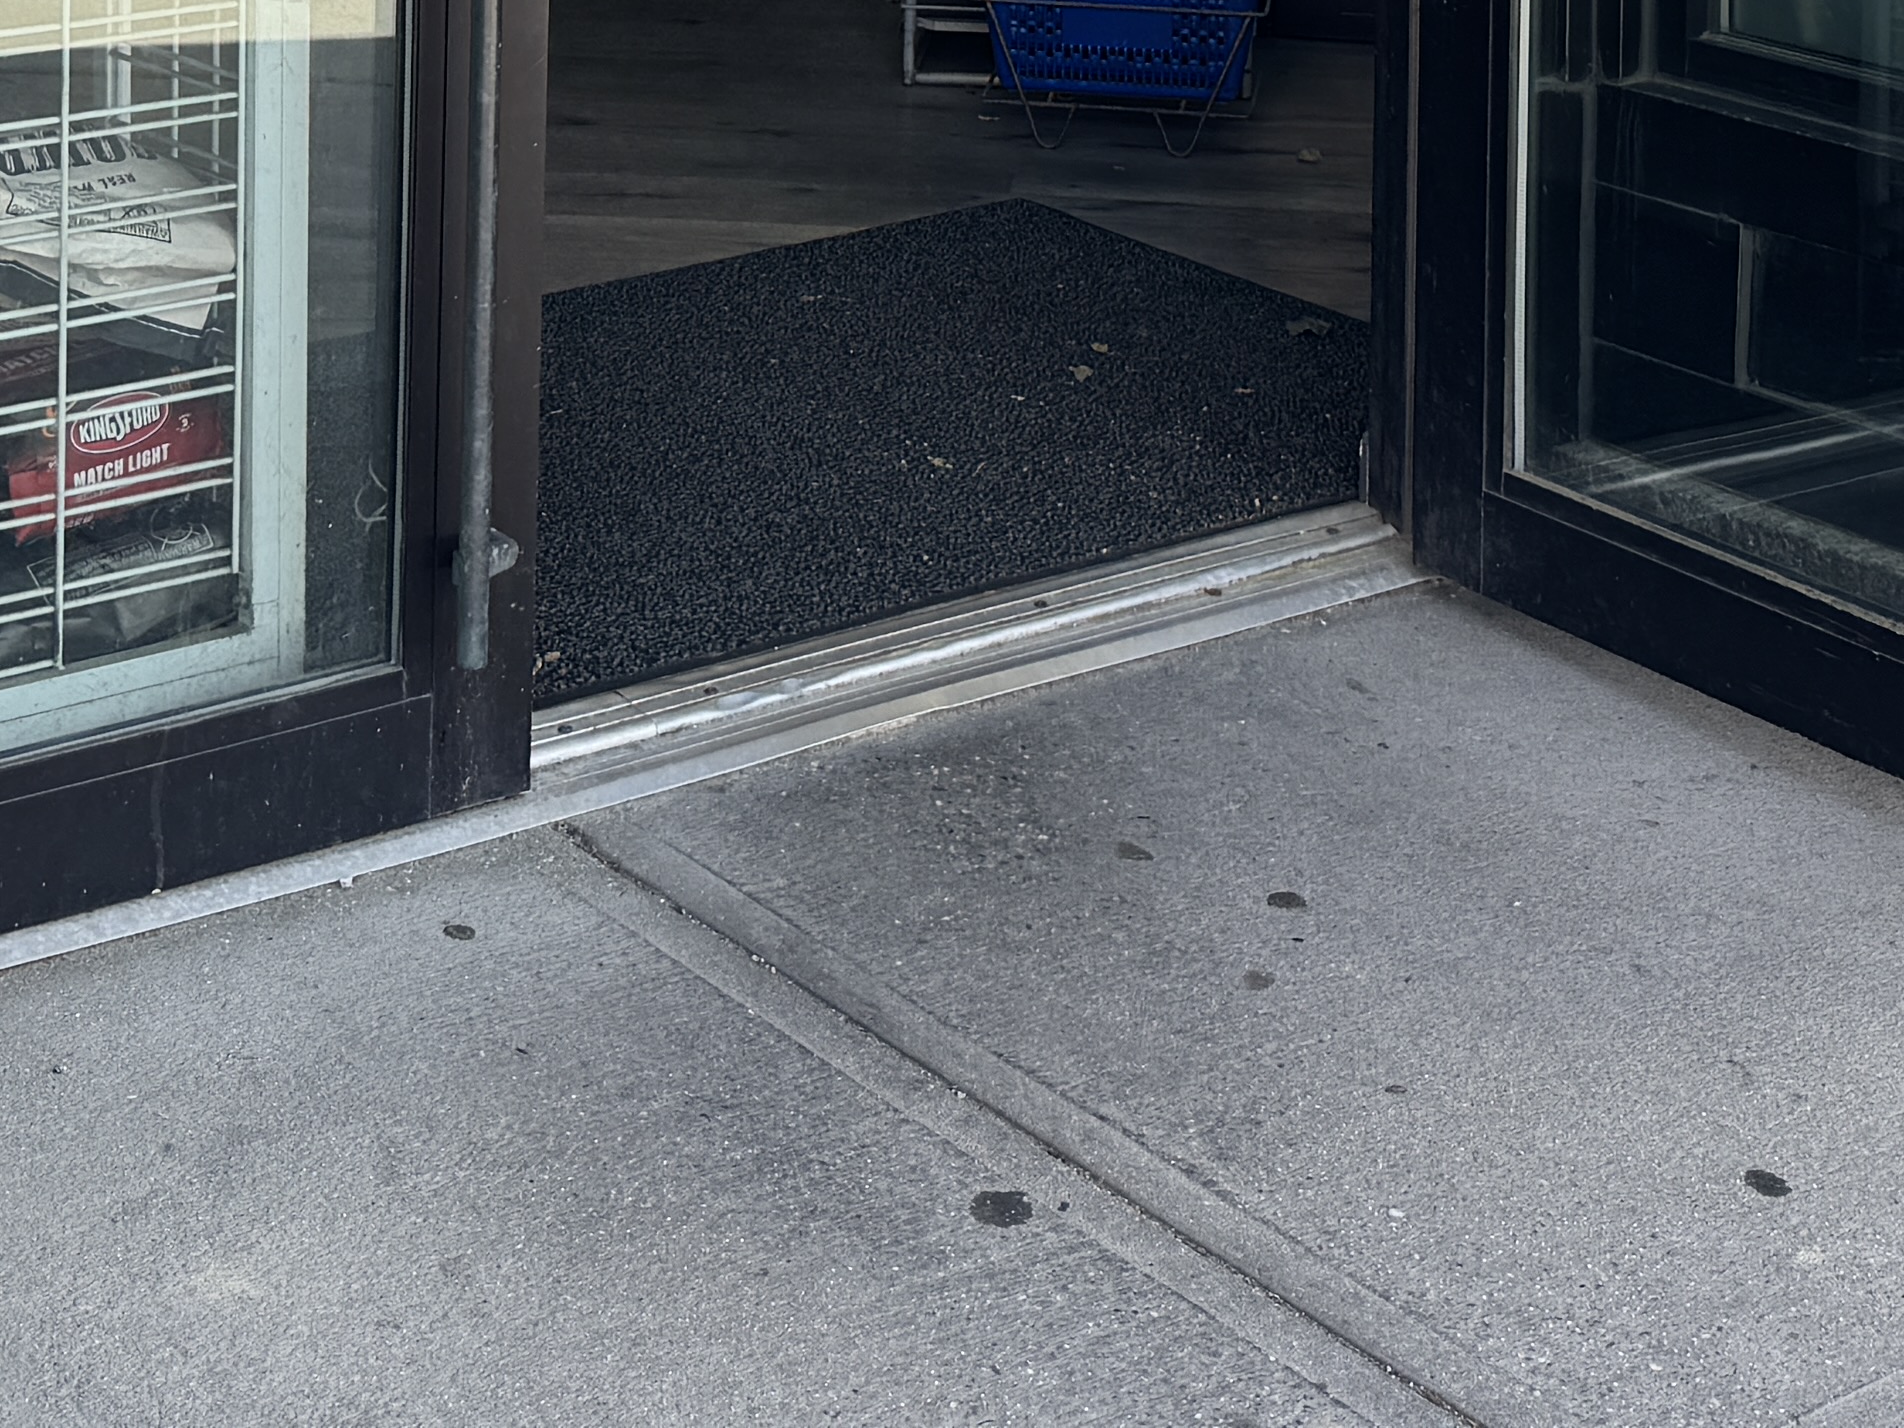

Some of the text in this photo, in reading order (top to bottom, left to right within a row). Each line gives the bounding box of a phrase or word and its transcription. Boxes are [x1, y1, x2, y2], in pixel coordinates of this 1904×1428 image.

[78, 401, 163, 444] KINGSFORD
[72, 443, 171, 489] MATCH LIGHT
